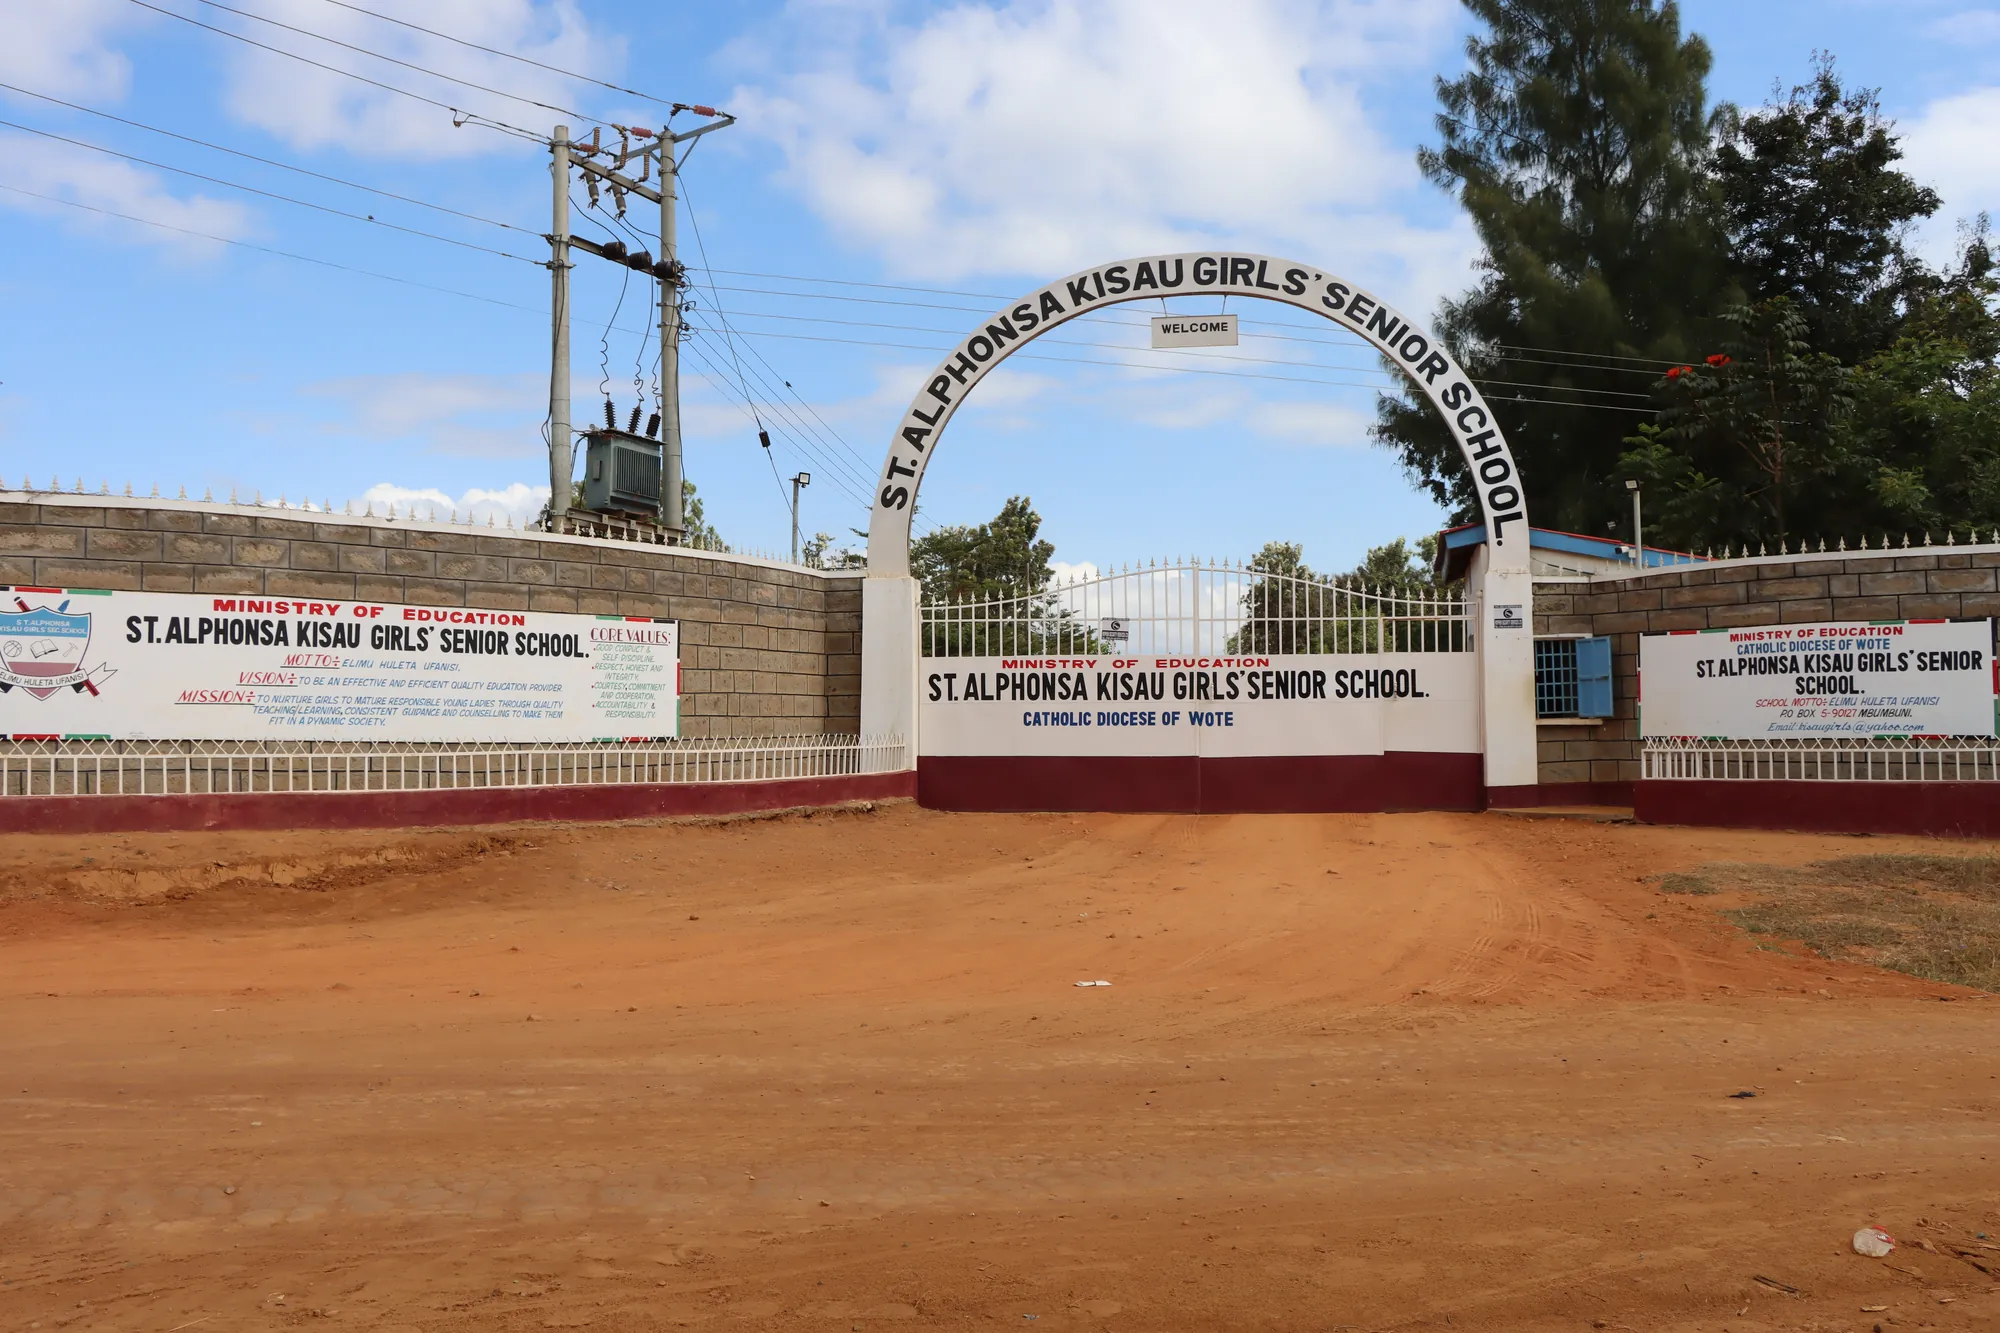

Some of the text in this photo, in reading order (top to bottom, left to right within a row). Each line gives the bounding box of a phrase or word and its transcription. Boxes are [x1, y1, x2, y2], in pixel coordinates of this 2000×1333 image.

[1161, 322, 1228, 334] WELCOME
[881, 456, 918, 511] ST.
[901, 290, 1066, 453] ALPHONSA
[1066, 258, 1184, 307] KISAU
[1321, 282, 1450, 386] SENIOR
[1441, 382, 1523, 547] SCHOOL.
[213, 599, 525, 626] MINISTRY OF EDUCATION
[165, 616, 289, 647] ALPHONSA
[297, 620, 361, 649] KISAU
[371, 625, 435, 652] GIRLS'
[440, 628, 509, 656] SENIOR
[515, 632, 590, 659] SCHOOL.
[590, 628, 671, 644] CORE VALUES:
[1730, 626, 1903, 643] MINISTRY OF EDUCATION
[615, 645, 643, 653] CONDUCT
[1737, 639, 1890, 655] CATHOLIC DIOCESE OF WOTE
[342, 659, 374, 669] ELIMU
[379, 660, 417, 670] HULETA
[626, 664, 649, 672] HONEST
[1002, 658, 1270, 669] MINISTRY OF EDUCATION
[1718, 655, 1800, 677] ALPHONSA
[1804, 653, 1851, 673] KISAU
[1858, 650, 1914, 673] GIRLS'
[1917, 650, 1983, 671] SENIOR
[0, 671, 85, 686] ELIMU HULETA UFANISI
[299, 676, 311, 685] TO
[313, 677, 325, 686] BE
[328, 677, 341, 686] AN
[342, 678, 387, 687] EFFECTIVE
[389, 679, 406, 688] AND
[407, 679, 449, 689] EFFICIENT
[450, 681, 484, 690] QUALITY
[486, 682, 528, 691] EDUCATION
[928, 673, 959, 702] ST.
[963, 672, 1089, 701] ALPHONSA
[1097, 672, 1164, 700] KISAU
[1247, 670, 1326, 699] SENIOR
[1334, 668, 1430, 699] SCHOOL.
[1795, 675, 1866, 695] SCHOOL.
[628, 683, 666, 691] COMMITMENT
[257, 694, 271, 703] TO
[271, 695, 313, 703] NURTURE
[315, 695, 339, 704] GIRLS
[341, 696, 353, 704] TO
[354, 696, 387, 705] MATURE
[388, 698, 440, 707] RESPONSIBLE
[443, 698, 468, 707] YOUNG
[469, 699, 495, 708] LADIES
[498, 700, 531, 708] THROUGH
[532, 700, 564, 709] QUALITY
[595, 701, 648, 709] ACCOUNTABILITY
[1755, 699, 1788, 707] SCHOOL
[1828, 697, 1857, 706] ELIMU
[1860, 697, 1897, 706] HULETA
[1901, 696, 1940, 706] UFANISI
[344, 706, 398, 716] CONSISTENT
[402, 708, 440, 717] GUIDANCE
[441, 709, 458, 717] AND
[459, 709, 510, 718] COUNSELLING
[512, 710, 522, 718] TO
[522, 710, 542, 718] MAKE
[544, 710, 564, 719] THEM
[1023, 711, 1234, 727] CATHOLIC DIOCESE OF WOTE
[1797, 709, 1816, 718] BOX
[1821, 708, 1858, 718] 5-90127
[1858, 709, 1913, 718] MBUMBUNI.
[268, 716, 386, 726] FIT IN A DYNAMIC SOCIETY.
